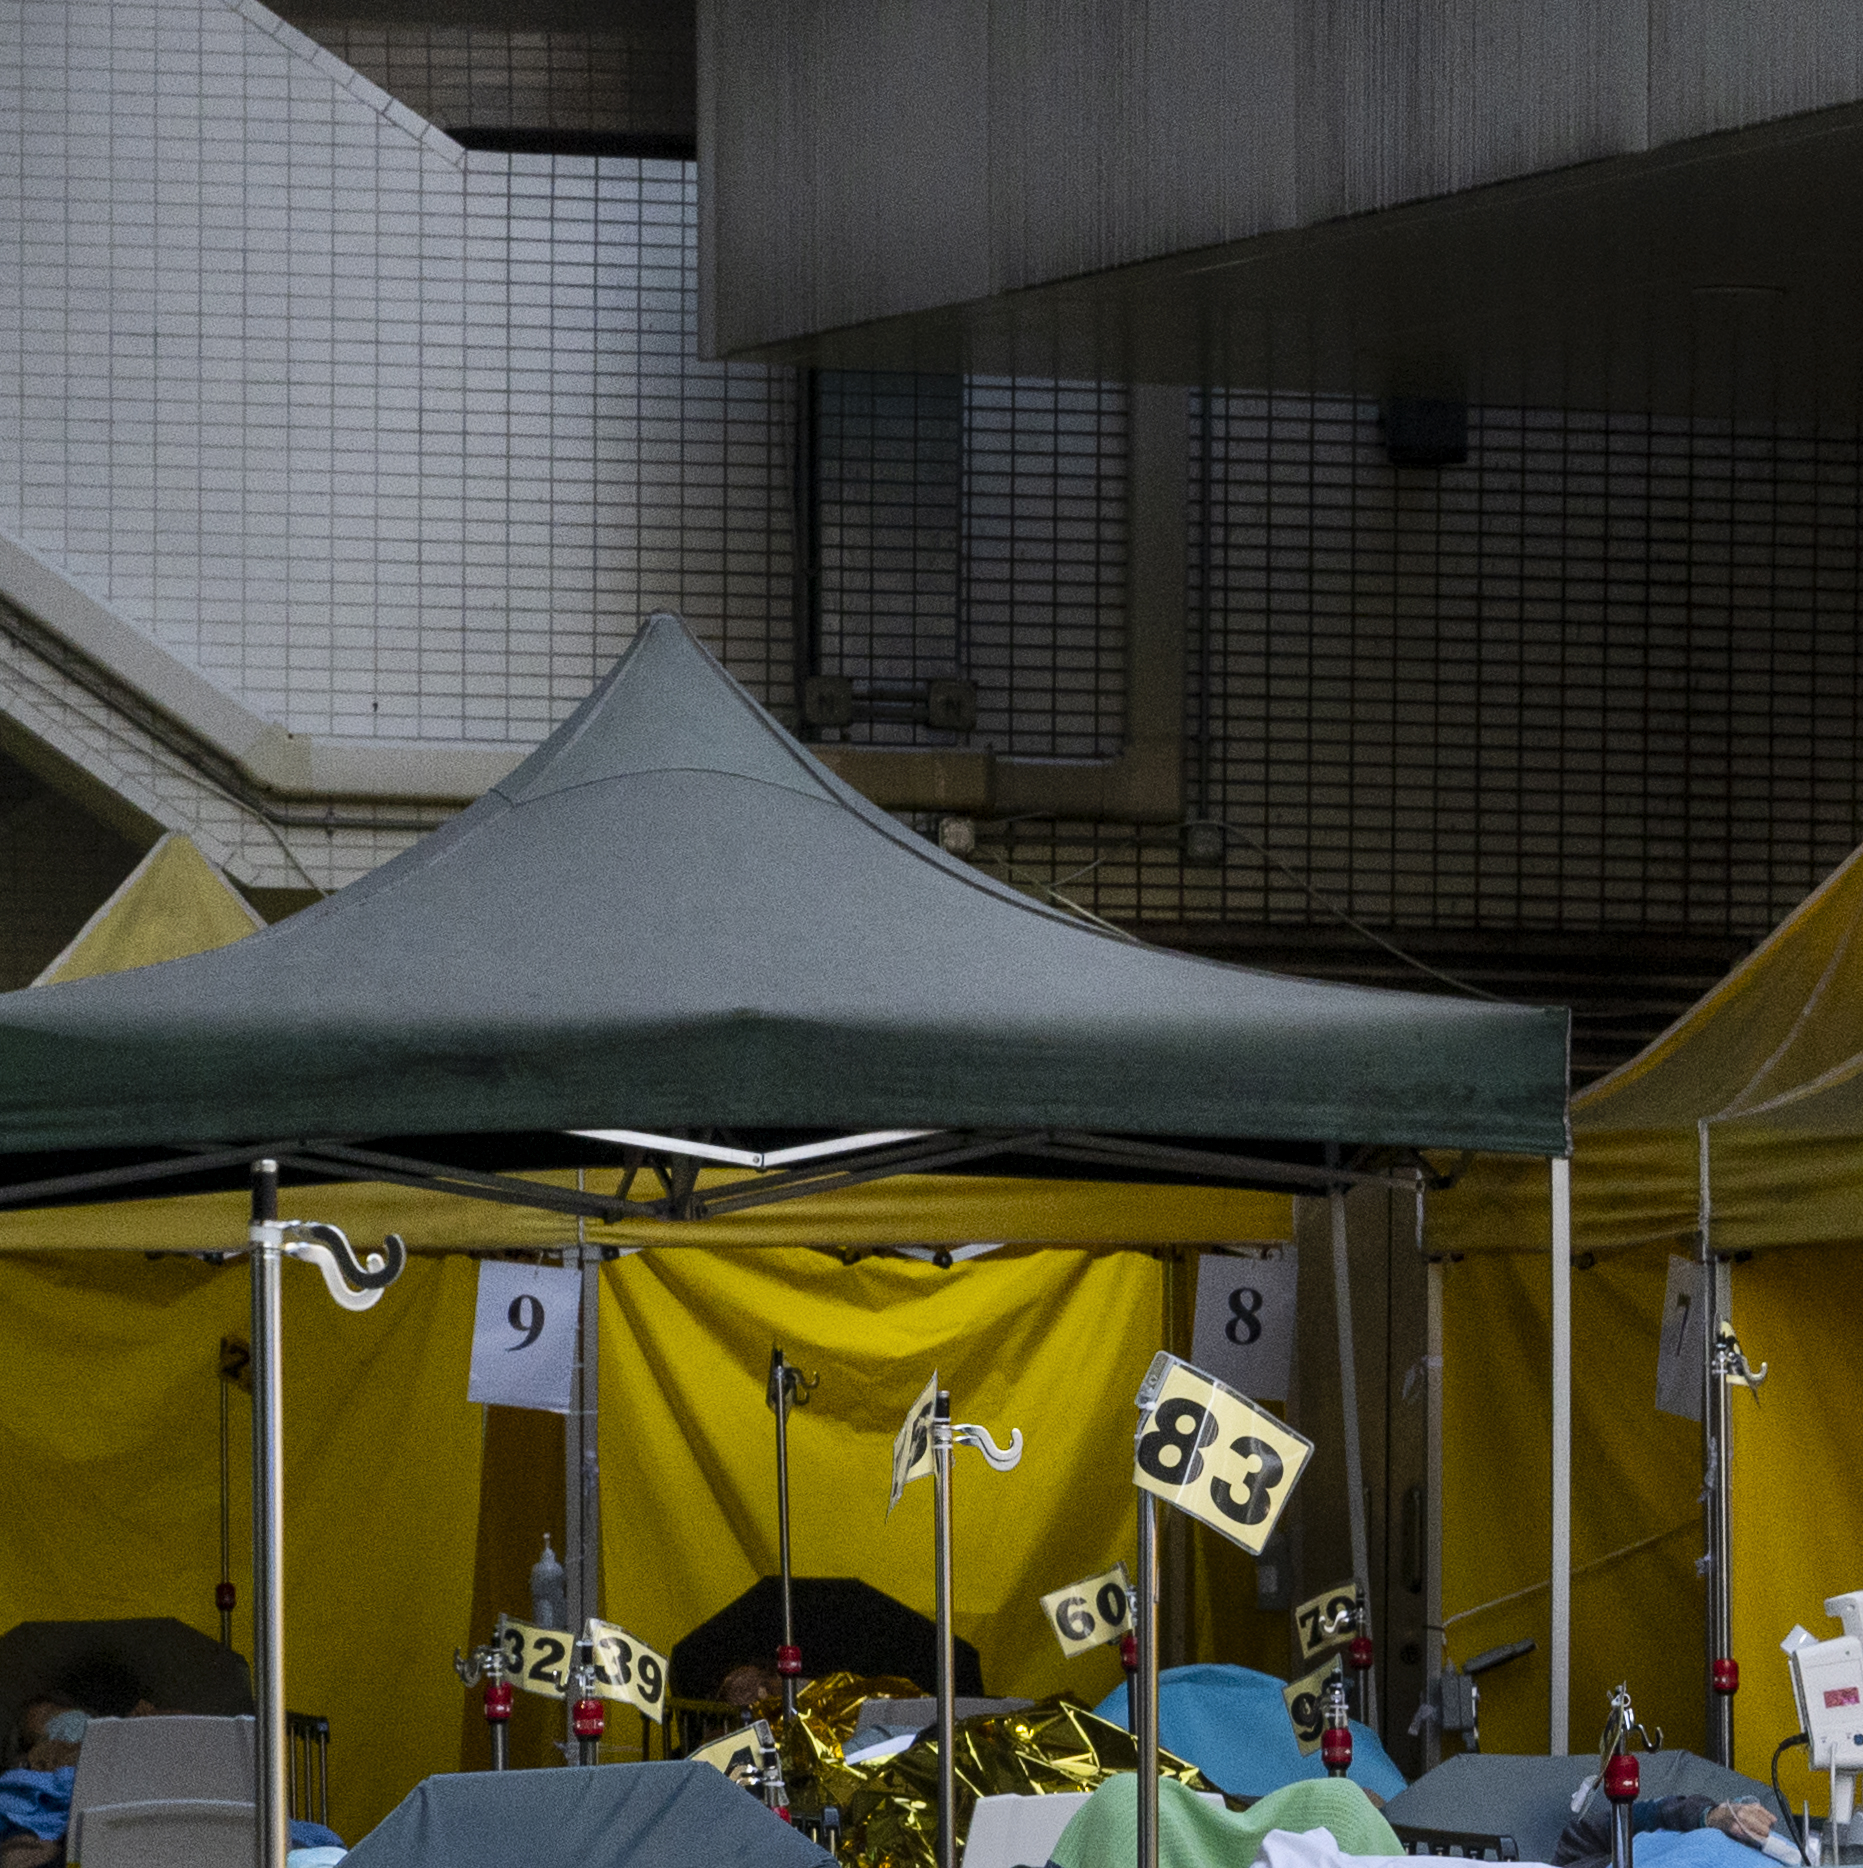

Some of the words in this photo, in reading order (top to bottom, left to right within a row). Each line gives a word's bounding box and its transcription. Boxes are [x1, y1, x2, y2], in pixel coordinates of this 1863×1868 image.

[507, 1294, 545, 1351] 9
[1225, 1287, 1263, 1345] 8
[1138, 1397, 1284, 1526] 83
[1056, 1583, 1127, 1641] 60
[504, 1627, 566, 1682] 32
[596, 1635, 663, 1703] 39
